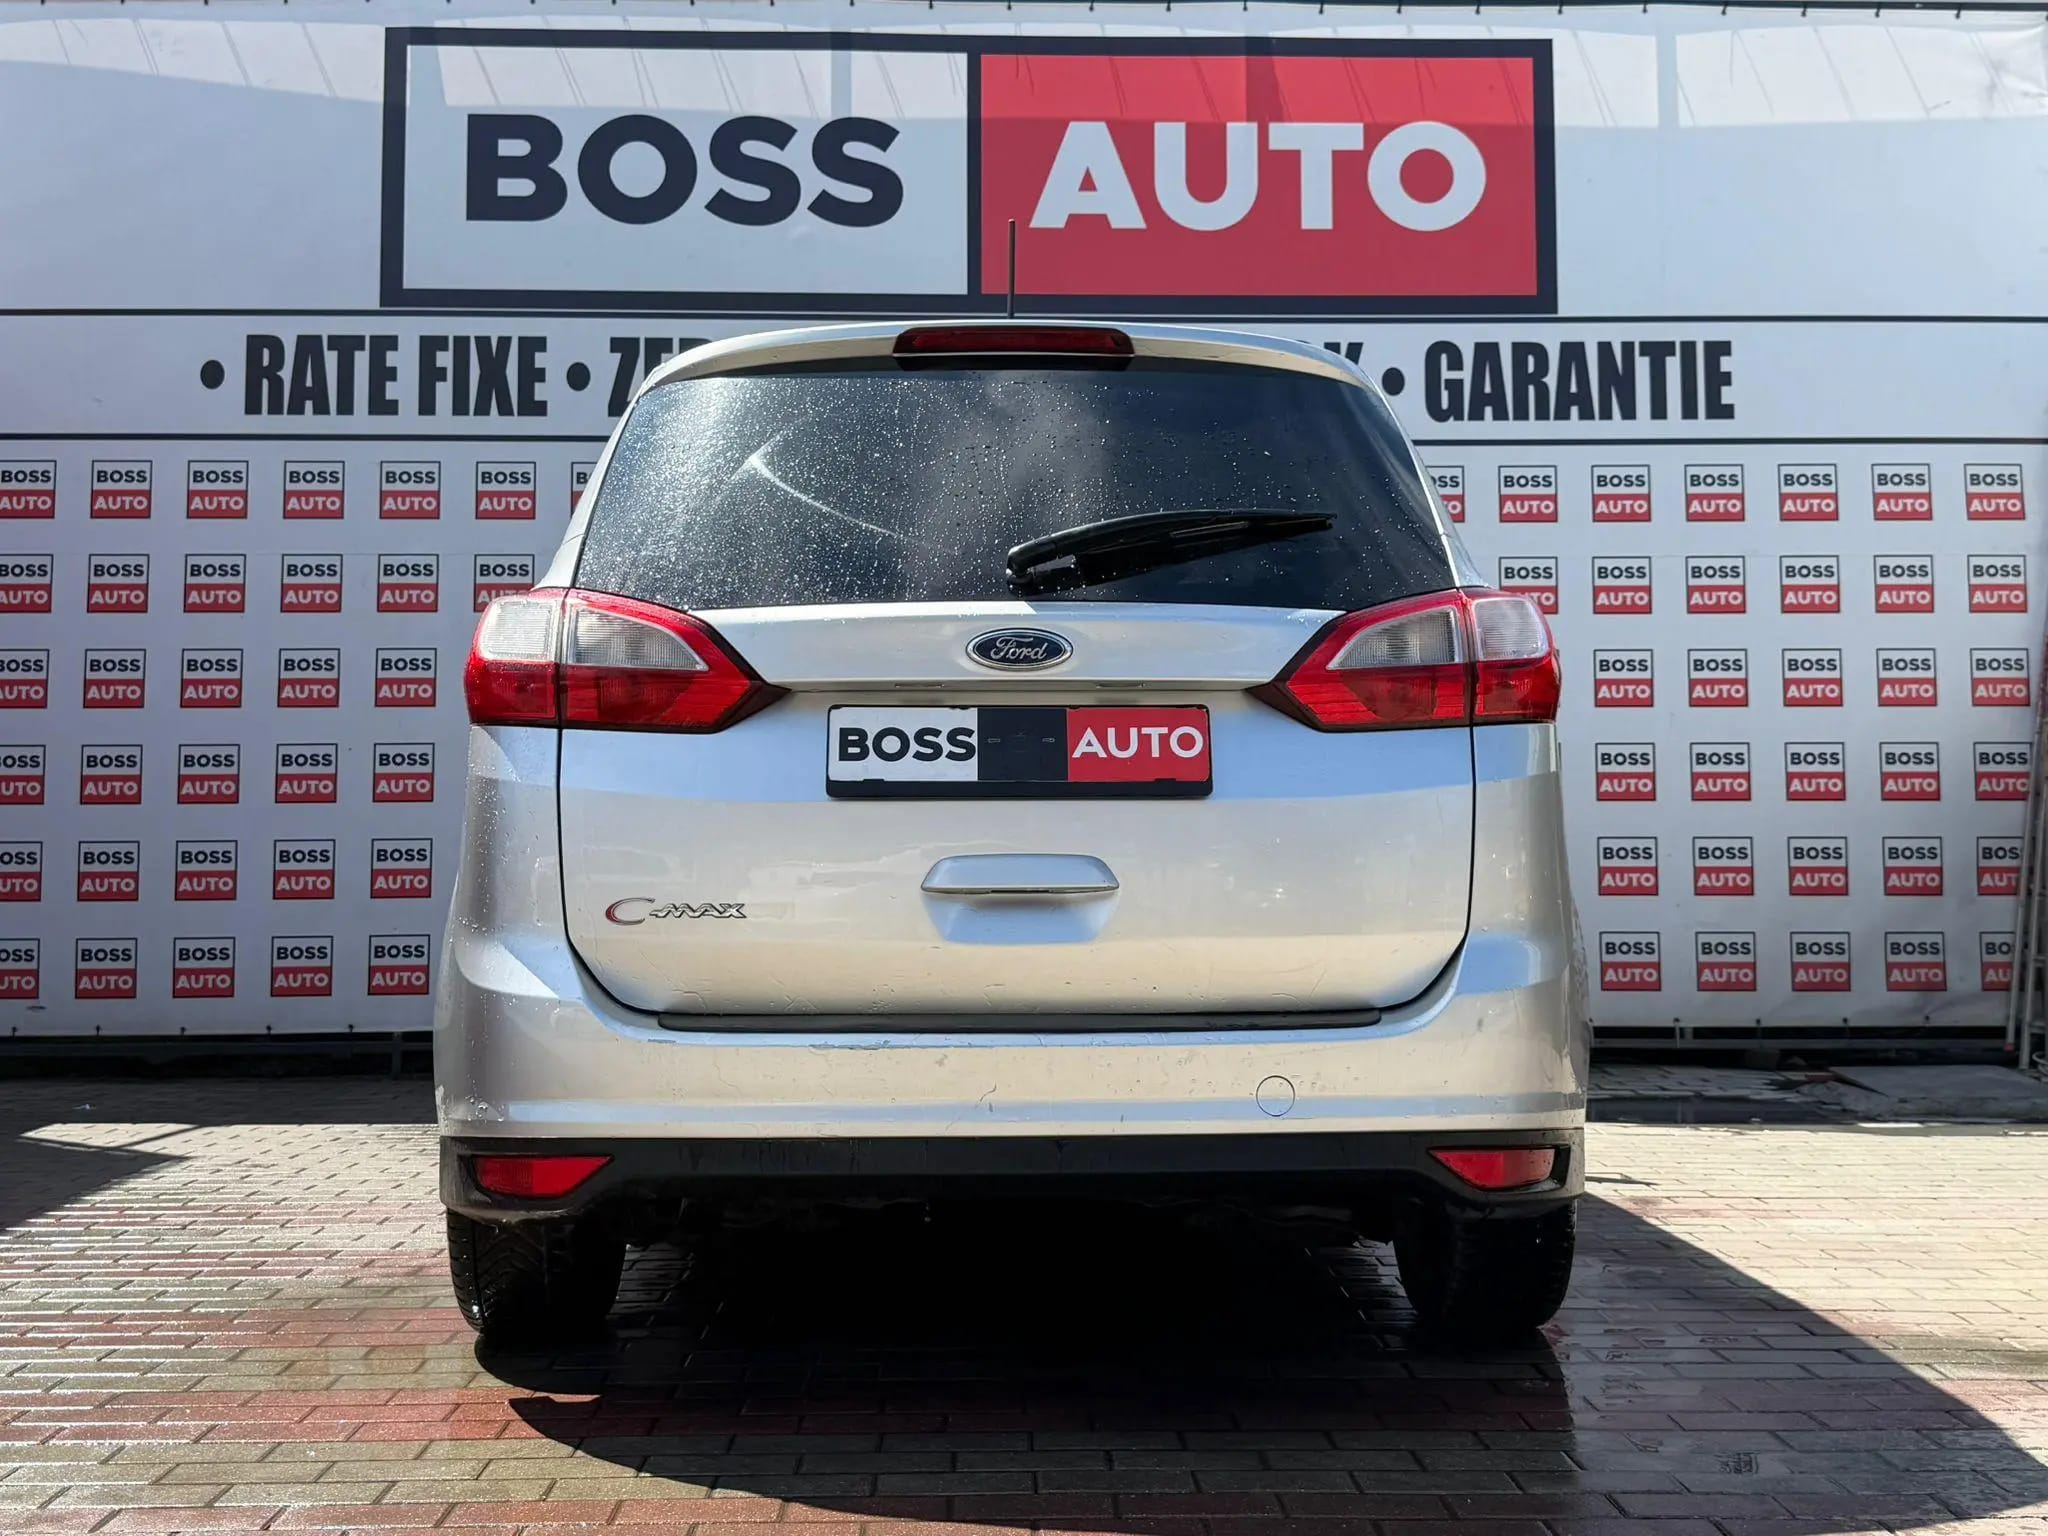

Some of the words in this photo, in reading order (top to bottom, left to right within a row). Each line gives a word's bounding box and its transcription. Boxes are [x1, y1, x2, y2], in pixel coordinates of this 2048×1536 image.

[465, 113, 905, 228] BOSS
[1028, 120, 1488, 233] AUTO
[243, 334, 399, 417] RATE
[417, 334, 548, 418] FIXE
[1423, 339, 1735, 422] GARANTIE
[0, 469, 52, 484] BOSS
[96, 469, 148, 484] BOSS
[192, 470, 244, 484] BOSS
[288, 470, 340, 484] BOSS
[385, 470, 436, 485] BOSS
[480, 471, 532, 485] BOSS
[1503, 474, 1553, 488] BOSS
[1596, 474, 1646, 488] BOSS
[1689, 473, 1740, 487] BOSS
[1783, 473, 1833, 487] BOSS
[1876, 473, 1927, 487] BOSS
[1969, 473, 2019, 487] BOSS
[0, 496, 52, 510] AUTO
[95, 495, 148, 510] AUTO
[191, 496, 245, 510] AUTO
[287, 496, 341, 511] AUTO
[382, 496, 437, 511] AUTO
[479, 497, 533, 511] AUTO
[1502, 500, 1555, 514] AUTO
[1595, 499, 1648, 514] AUTO
[1688, 499, 1742, 513] AUTO
[1782, 498, 1835, 513] AUTO
[1876, 498, 1930, 513] AUTO
[1969, 498, 2022, 512] AUTO
[0, 564, 49, 577] BOSS
[93, 563, 145, 578] BOSS
[189, 563, 241, 578] BOSS
[286, 563, 338, 578] BOSS
[383, 563, 434, 577] BOSS
[479, 563, 530, 577] BOSS
[1503, 566, 1554, 580] BOSS
[1597, 565, 1647, 580] BOSS
[1690, 565, 1741, 579] BOSS
[1785, 564, 1835, 579] BOSS
[1879, 564, 1929, 578] BOSS
[1972, 564, 2022, 578] BOSS
[91, 590, 145, 604] AUTO
[187, 589, 241, 604] AUTO
[284, 589, 339, 604] AUTO
[381, 589, 435, 604] AUTO
[1595, 591, 1649, 606] AUTO
[1689, 591, 1743, 605] AUTO
[1784, 590, 1837, 605] AUTO
[1878, 590, 1931, 605] AUTO
[1971, 590, 2025, 604] AUTO
[990, 635, 1048, 661] Ford
[89, 658, 141, 673] BOSS
[186, 658, 238, 673] BOSS
[283, 657, 335, 672] BOSS
[380, 657, 432, 672] BOSS
[1598, 658, 1649, 673] BOSS
[1692, 658, 1743, 672] BOSS
[1787, 658, 1838, 672] BOSS
[1881, 657, 1932, 672] BOSS
[1975, 657, 2025, 672] BOSS
[0, 685, 45, 699] UTO
[87, 685, 142, 700] AUTO
[184, 684, 239, 699] AUTO
[281, 684, 336, 699] AUTO
[378, 684, 433, 698] AUTO
[1597, 684, 1651, 699] AUTO
[1691, 684, 1746, 699] AUTO
[1786, 684, 1840, 698] AUTO
[1881, 683, 1935, 698] AUTO
[1974, 683, 2027, 698] AUTO
[838, 726, 977, 762] BOSS
[1071, 726, 1204, 759] AUTO
[0, 755, 41, 768] OSS
[86, 754, 138, 769] BOSS
[183, 753, 235, 768] BOSS
[281, 753, 333, 767] BOSS
[378, 752, 430, 767] BOSS
[1600, 752, 1651, 766] BOSS
[1695, 752, 1746, 766] BOSS
[1790, 751, 1840, 766] BOSS
[1884, 751, 1935, 766] BOSS
[1978, 751, 2029, 766] BOSS
[1, 781, 41, 795] UTO
[83, 781, 138, 796] AUTO
[181, 780, 236, 795] AUTO
[279, 780, 334, 795] AUTO
[376, 779, 431, 794] AUTO
[1599, 778, 1653, 793] AUTO
[1694, 778, 1749, 792] AUTO
[1789, 778, 1843, 793] AUTO
[1883, 778, 1937, 792] AUTO
[0, 851, 38, 865] OSS
[83, 850, 135, 865] BOSS
[180, 850, 233, 865] BOSS
[278, 849, 331, 864] BOSS
[376, 848, 428, 863] BOSS
[1602, 846, 1653, 860] BOSS
[1698, 846, 1749, 860] BOSS
[1793, 846, 1843, 860] BOSS
[1887, 846, 1939, 861] BOSS
[1981, 846, 2021, 860] BOS
[0, 878, 39, 892] UTO
[81, 877, 136, 893] AUTO
[178, 877, 233, 892] AUTO
[277, 876, 331, 891] AUTO
[374, 875, 429, 890] AUTO
[1601, 872, 1655, 887] AUTO
[1696, 872, 1751, 887] AUTO
[1792, 872, 1846, 887] AUTO
[1886, 872, 1940, 888] AUTO
[1980, 873, 2019, 887] AUT
[0, 948, 35, 962] OSS
[80, 947, 133, 963] BOSS
[178, 947, 231, 962] BOSS
[276, 945, 328, 961] BOSS
[373, 944, 426, 959] BOSS
[1604, 941, 1656, 956] BOSS
[1700, 941, 1752, 956] BOSS
[1795, 941, 1846, 956] BOSS
[1889, 941, 1941, 956] BOSS
[176, 974, 231, 989] AUTO
[274, 972, 329, 988] AUTO
[371, 971, 427, 987] AUTO
[1604, 967, 1658, 982] AUTO
[1699, 968, 1753, 983] AUTO
[1794, 968, 1848, 983] AUTO
[1889, 968, 1943, 983] AUTO
[78, 975, 133, 990] AUTO
